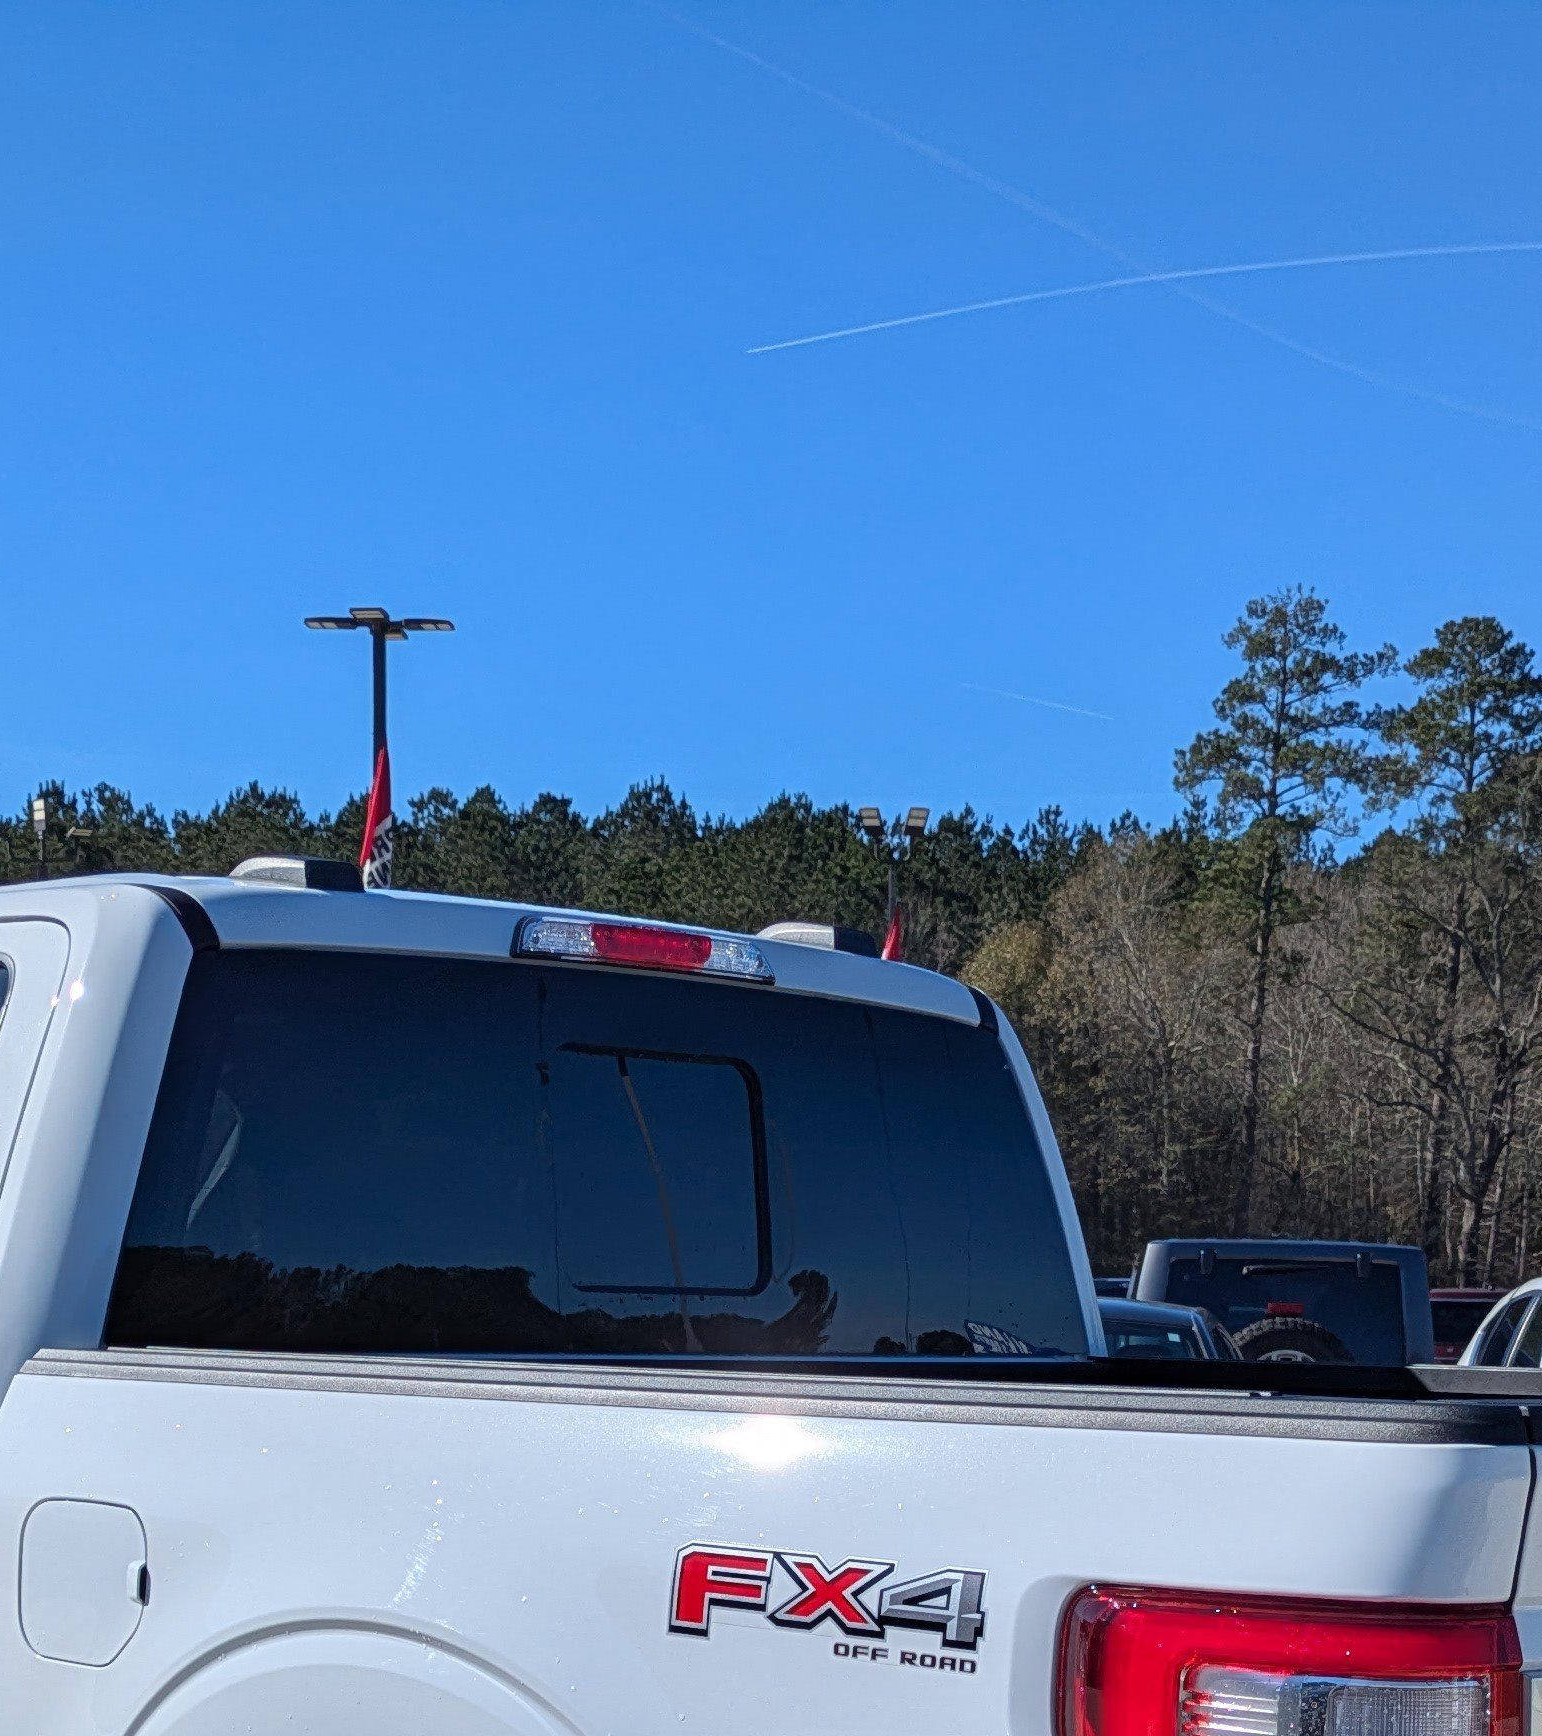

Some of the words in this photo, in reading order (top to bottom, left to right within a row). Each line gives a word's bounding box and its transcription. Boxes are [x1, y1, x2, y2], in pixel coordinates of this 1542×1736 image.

[666, 1541, 989, 1652] FX4
[832, 1641, 890, 1662] OFF
[899, 1649, 977, 1675] ROAD
